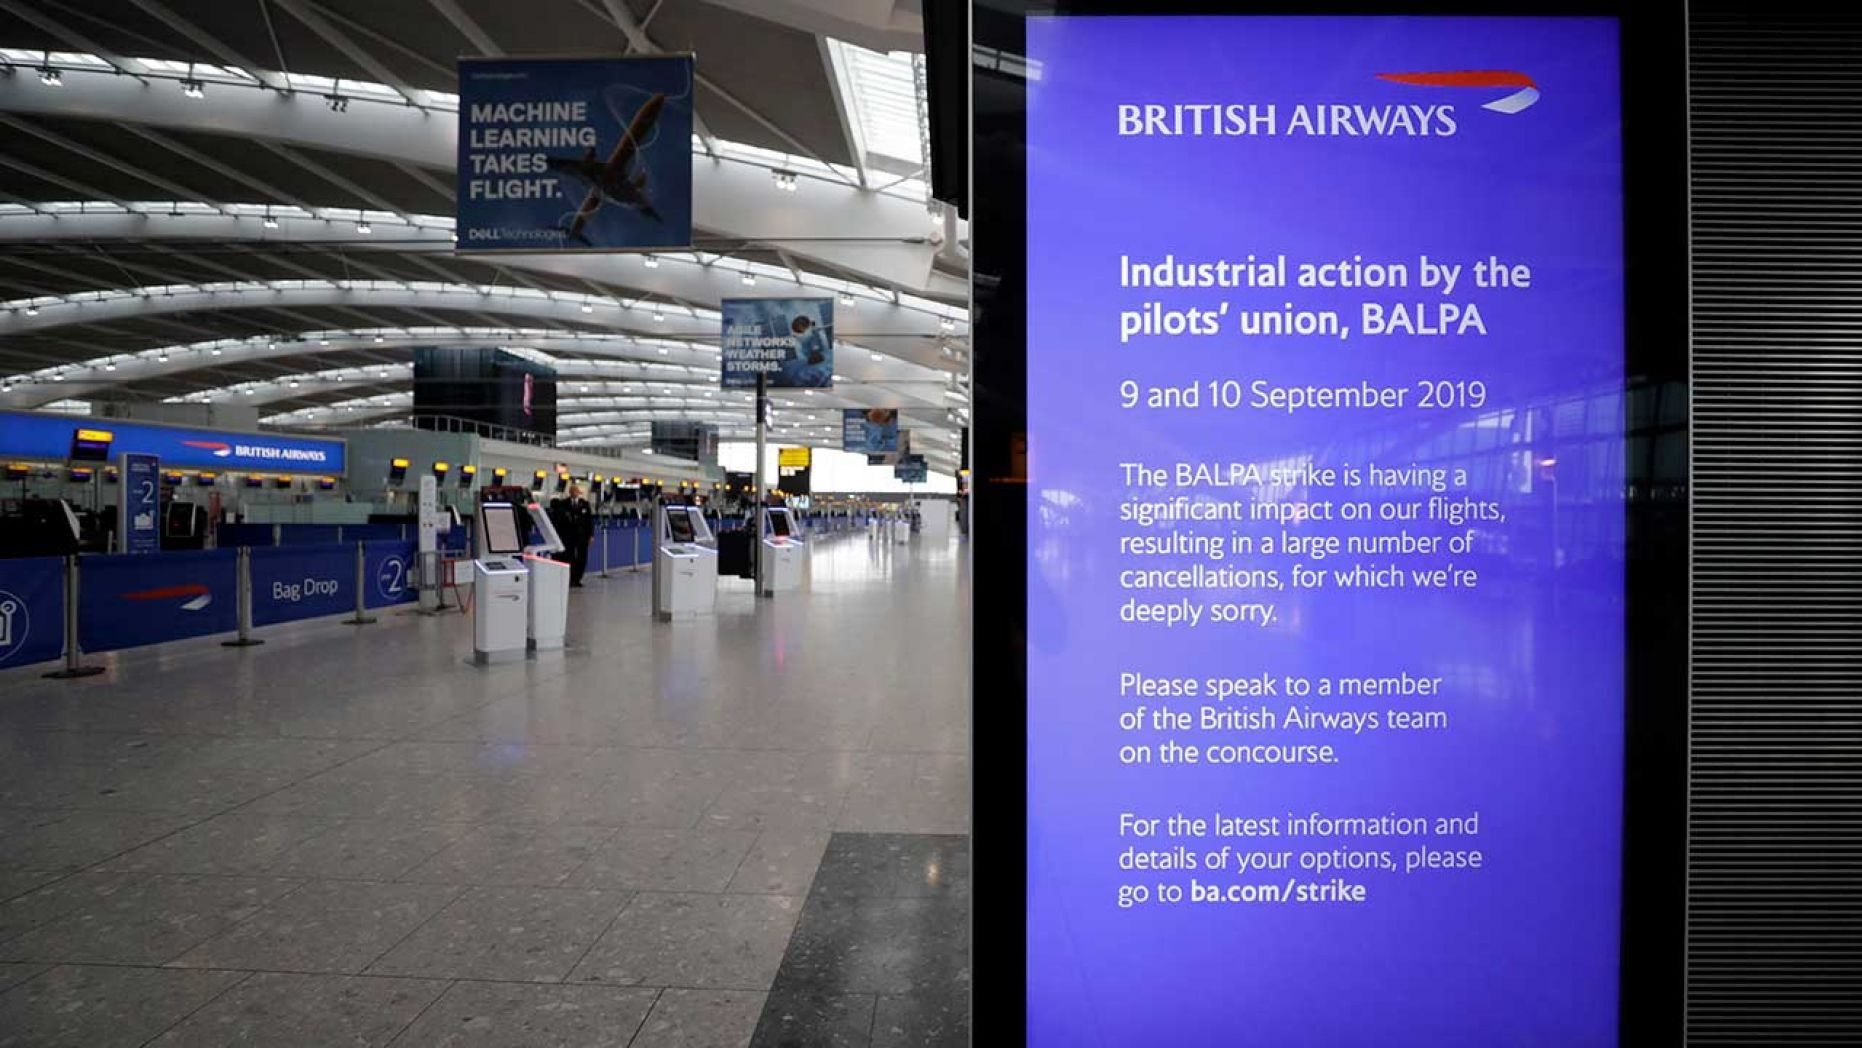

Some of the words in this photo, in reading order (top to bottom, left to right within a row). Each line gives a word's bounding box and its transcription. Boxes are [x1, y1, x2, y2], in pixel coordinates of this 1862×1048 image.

[471, 102, 586, 123] MACHINE
[1118, 104, 1276, 136] BRITISH
[1286, 104, 1457, 136] AIRWAYS
[470, 127, 596, 148] LEARNING
[470, 154, 547, 173] TAKES
[470, 179, 562, 199] FLIGHT.
[1121, 255, 1285, 287] Industrial
[1298, 257, 1407, 287] action
[1420, 255, 1462, 295] by
[1473, 256, 1531, 288] the
[1241, 305, 1349, 340] union,
[1362, 303, 1487, 335] BALPA
[726, 349, 786, 359] WEATHER
[727, 360, 782, 371] STORMS.
[1120, 380, 1138, 408] 9
[1148, 380, 1199, 408] and
[1208, 380, 1241, 408] 10
[1250, 380, 1409, 414] September
[1417, 380, 1486, 408] 2019
[235, 446, 280, 458] BRITISH
[281, 450, 326, 461] AIRWAYS
[142, 481, 153, 503] 2
[1121, 464, 1167, 486] The
[1176, 464, 1261, 486] BALPA
[1271, 463, 1335, 486] strike
[1344, 465, 1361, 486] is
[1370, 463, 1445, 493] having
[1454, 470, 1466, 486] a
[1120, 498, 1241, 526] significant
[1251, 499, 1331, 526] impact
[1341, 503, 1371, 521] on
[1379, 503, 1421, 521] our
[1429, 497, 1505, 526] flights,
[1120, 531, 1223, 560] resulting
[1232, 533, 1253, 554] in
[1261, 538, 1274, 554] a
[1283, 531, 1339, 560] large
[1348, 531, 1441, 554] number
[1449, 530, 1473, 554] of
[273, 582, 300, 601] Bag
[304, 578, 338, 599] Drop
[389, 560, 400, 592] 2
[1120, 566, 1284, 592] cancellations,
[1292, 565, 1326, 588] for
[1335, 565, 1404, 588] which
[1120, 599, 1202, 628] deeply
[1210, 605, 1277, 627] sorry.
[1120, 674, 1197, 695] Please
[1206, 672, 1277, 700] speak
[1285, 676, 1309, 695] to
[1318, 679, 1330, 695] a
[1339, 673, 1441, 695] member
[1120, 707, 1145, 729] of
[1153, 707, 1191, 729] the
[1201, 706, 1275, 729] British
[1284, 707, 1378, 734] Airways
[1387, 709, 1447, 729] team
[1120, 745, 1151, 763] on
[1160, 740, 1198, 763] the
[1207, 745, 1338, 763] concourse.
[1120, 813, 1160, 837] For
[1167, 813, 1206, 837] the
[1215, 812, 1280, 836] latest
[1288, 812, 1427, 836] information
[1435, 811, 1479, 835] and
[1119, 846, 1197, 869] details
[1205, 846, 1231, 869] of
[1236, 851, 1293, 874] your
[1300, 847, 1397, 874] options,
[1406, 845, 1482, 874] please
[1118, 885, 1149, 908] go
[1157, 883, 1182, 903] to
[1191, 878, 1366, 902] ba.com/strike
